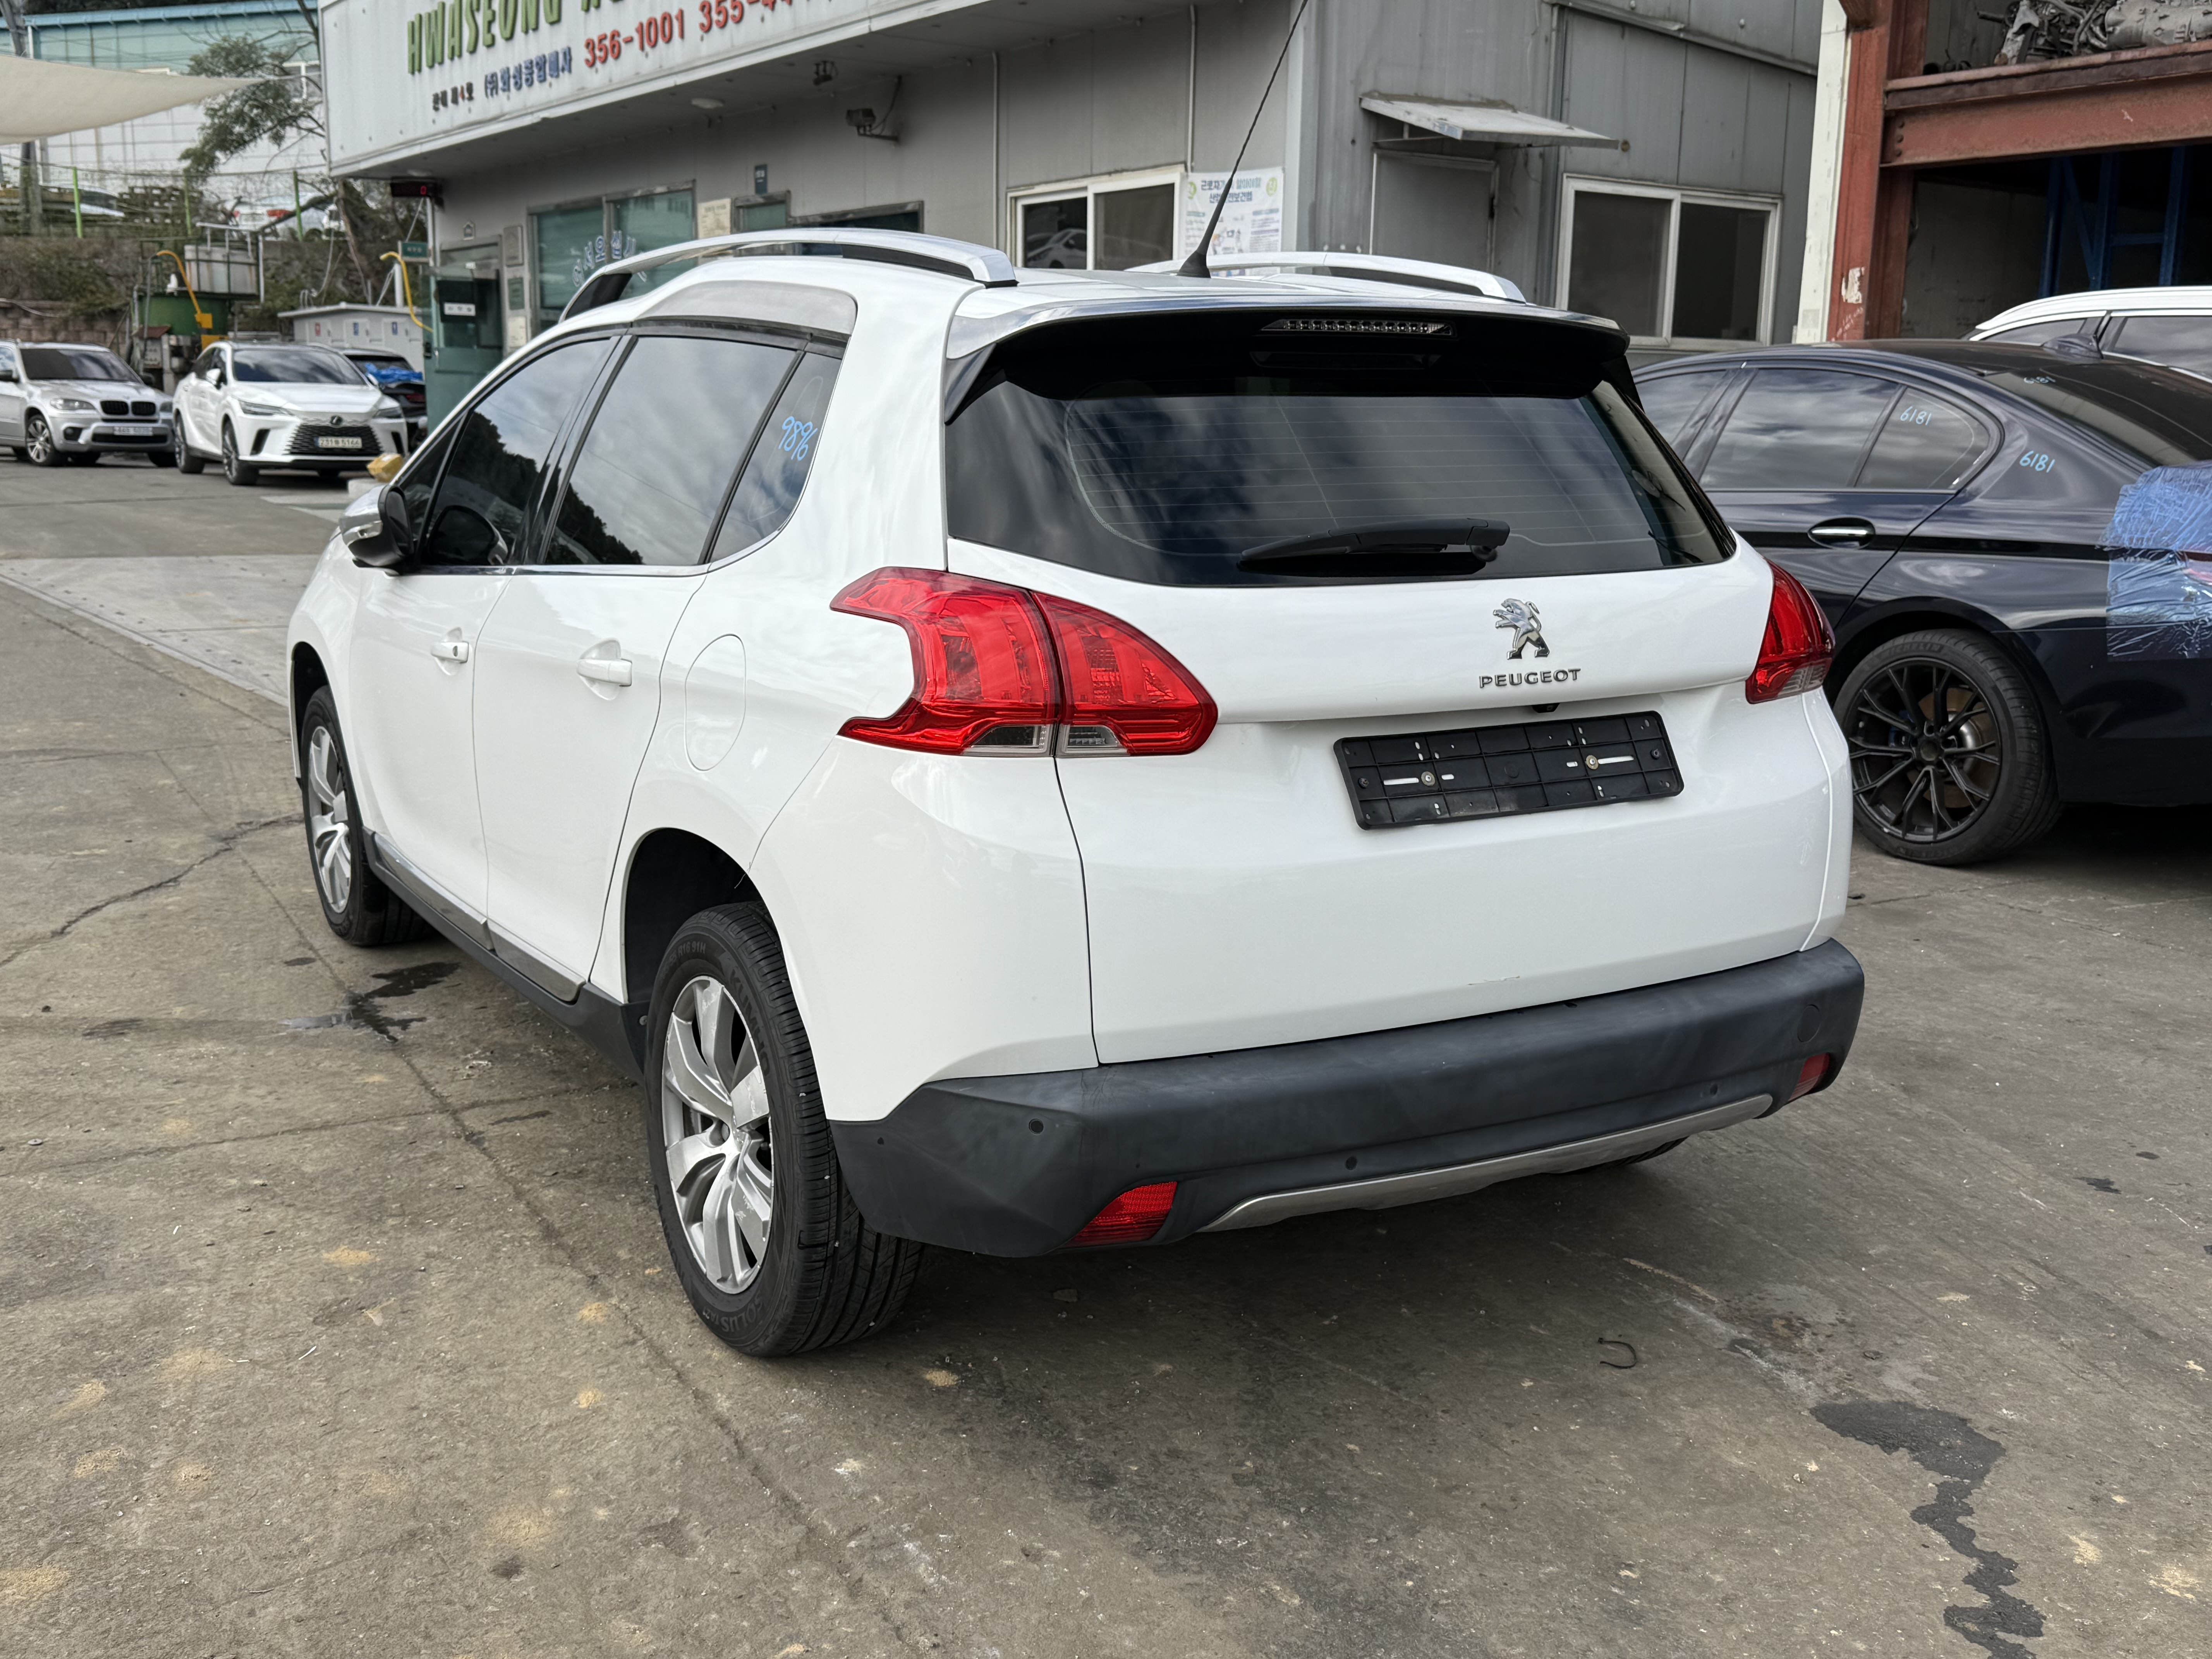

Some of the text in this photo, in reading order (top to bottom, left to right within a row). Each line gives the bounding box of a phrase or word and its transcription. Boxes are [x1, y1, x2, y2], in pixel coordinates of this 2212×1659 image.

[584, 0, 792, 68] 356-1001 355-
[572, 230, 647, 287] 어서오십시
[1900, 405, 1932, 426] 6181
[2020, 450, 2055, 473] 6181
[1479, 668, 1581, 689] PEUGEOT
[692, 940, 706, 955] 91H
[730, 969, 771, 1077] KUMHO
[720, 1289, 763, 1332] SOLUS
